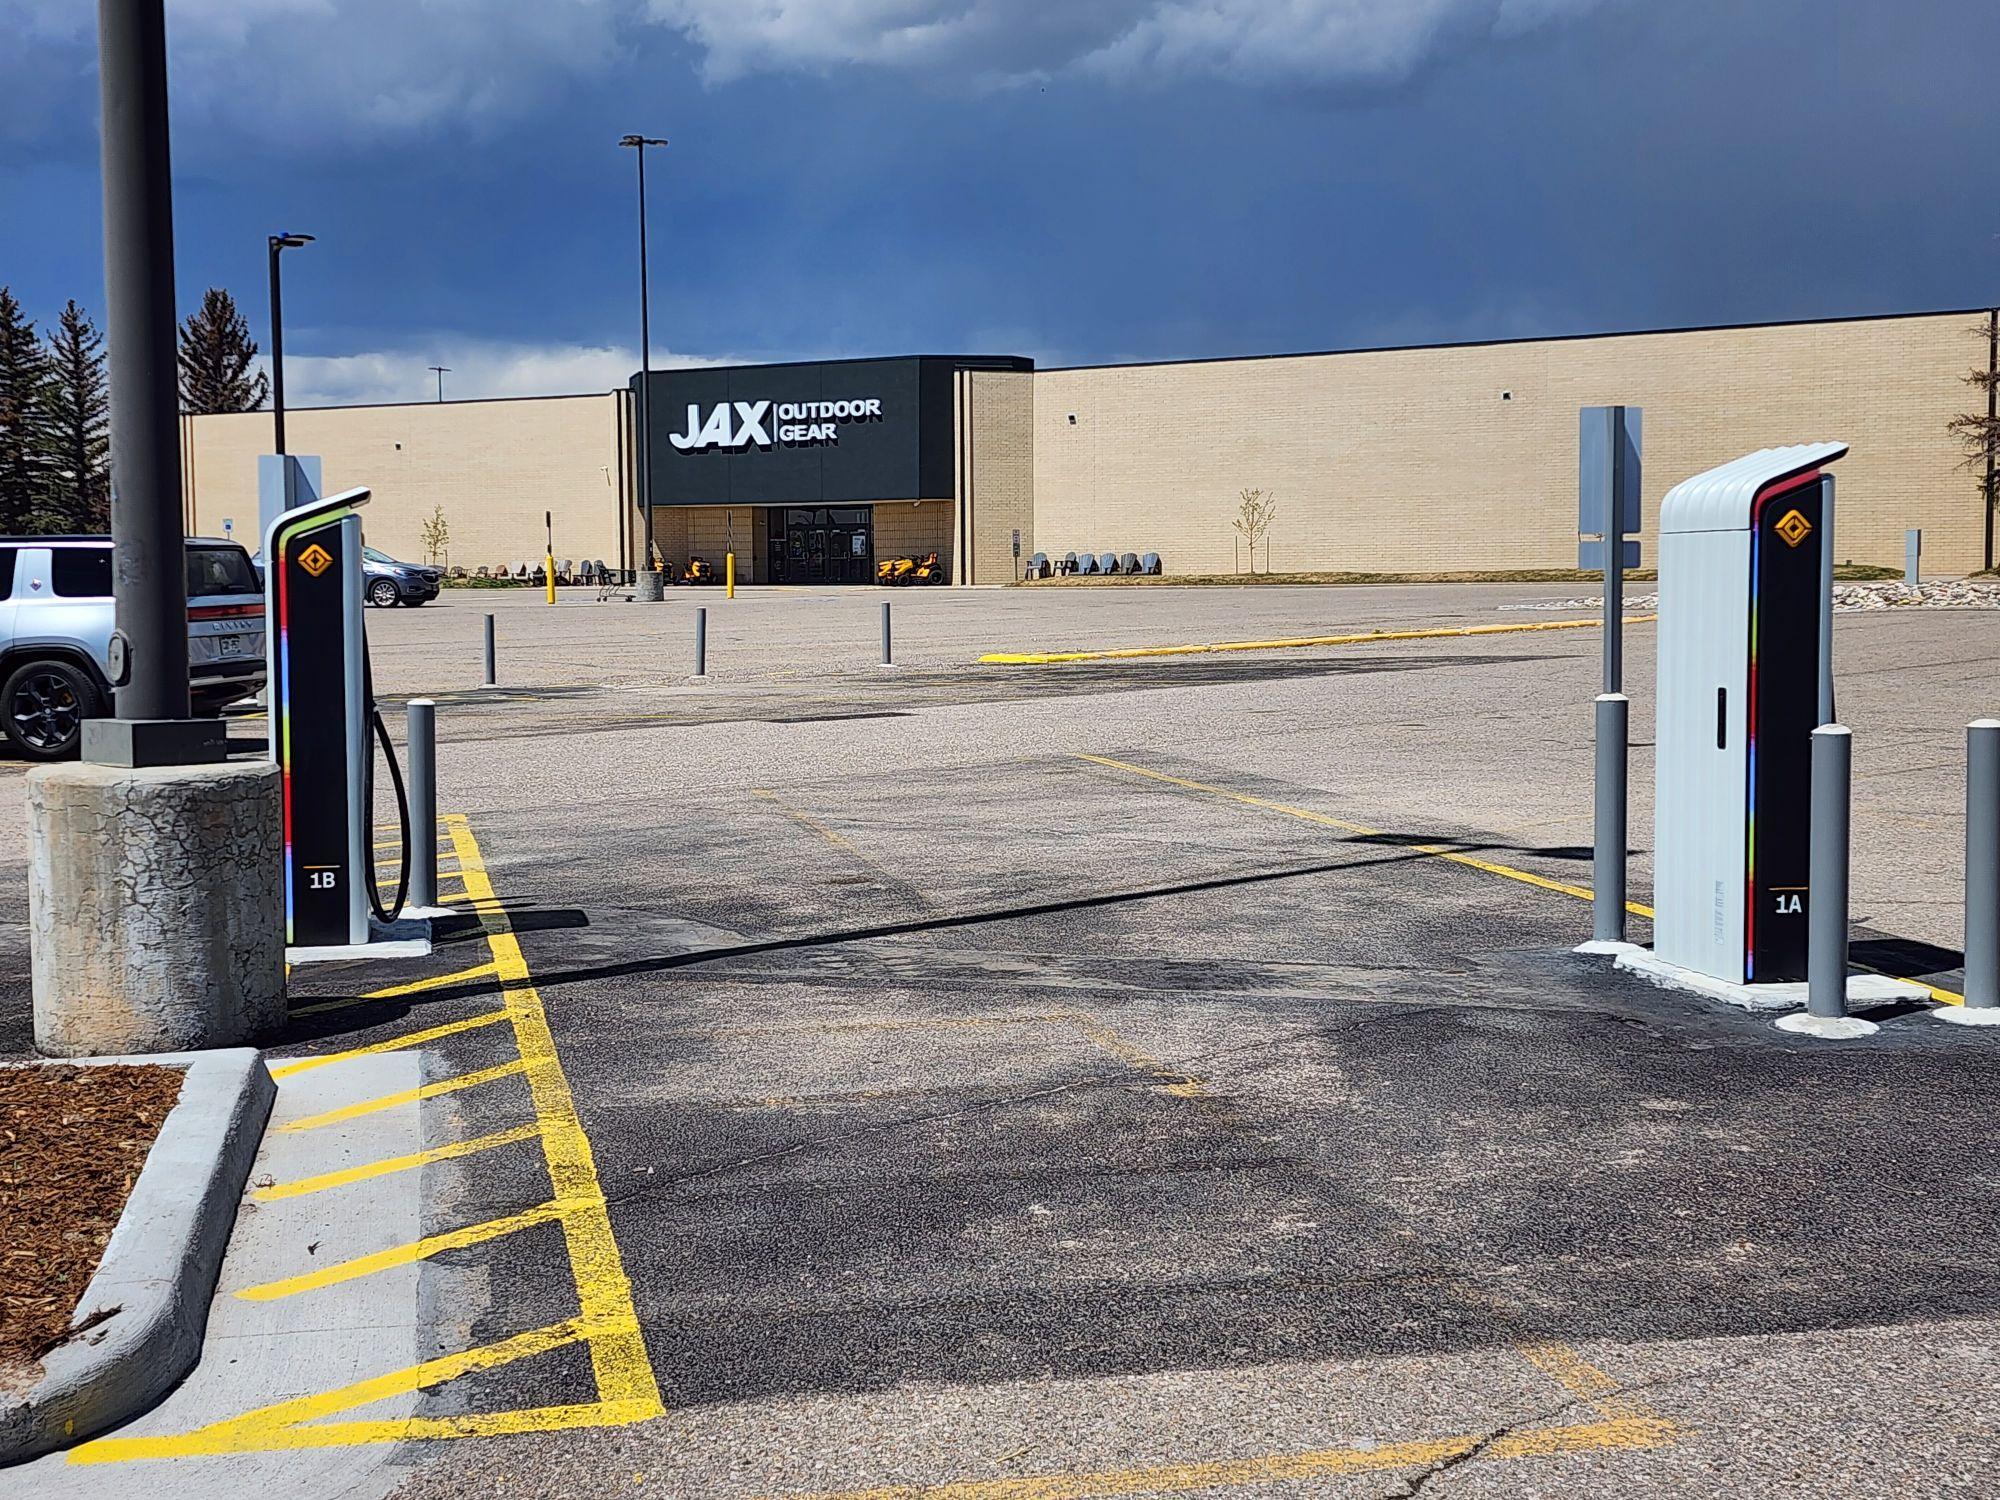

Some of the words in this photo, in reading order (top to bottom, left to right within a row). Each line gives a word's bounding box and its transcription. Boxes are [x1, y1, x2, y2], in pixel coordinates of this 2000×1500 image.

[778, 399, 882, 420] OUTDOOR
[669, 400, 771, 449] JAX
[779, 423, 838, 442] GEAR
[310, 872, 336, 889] 1B
[1775, 894, 1802, 914] 1A
